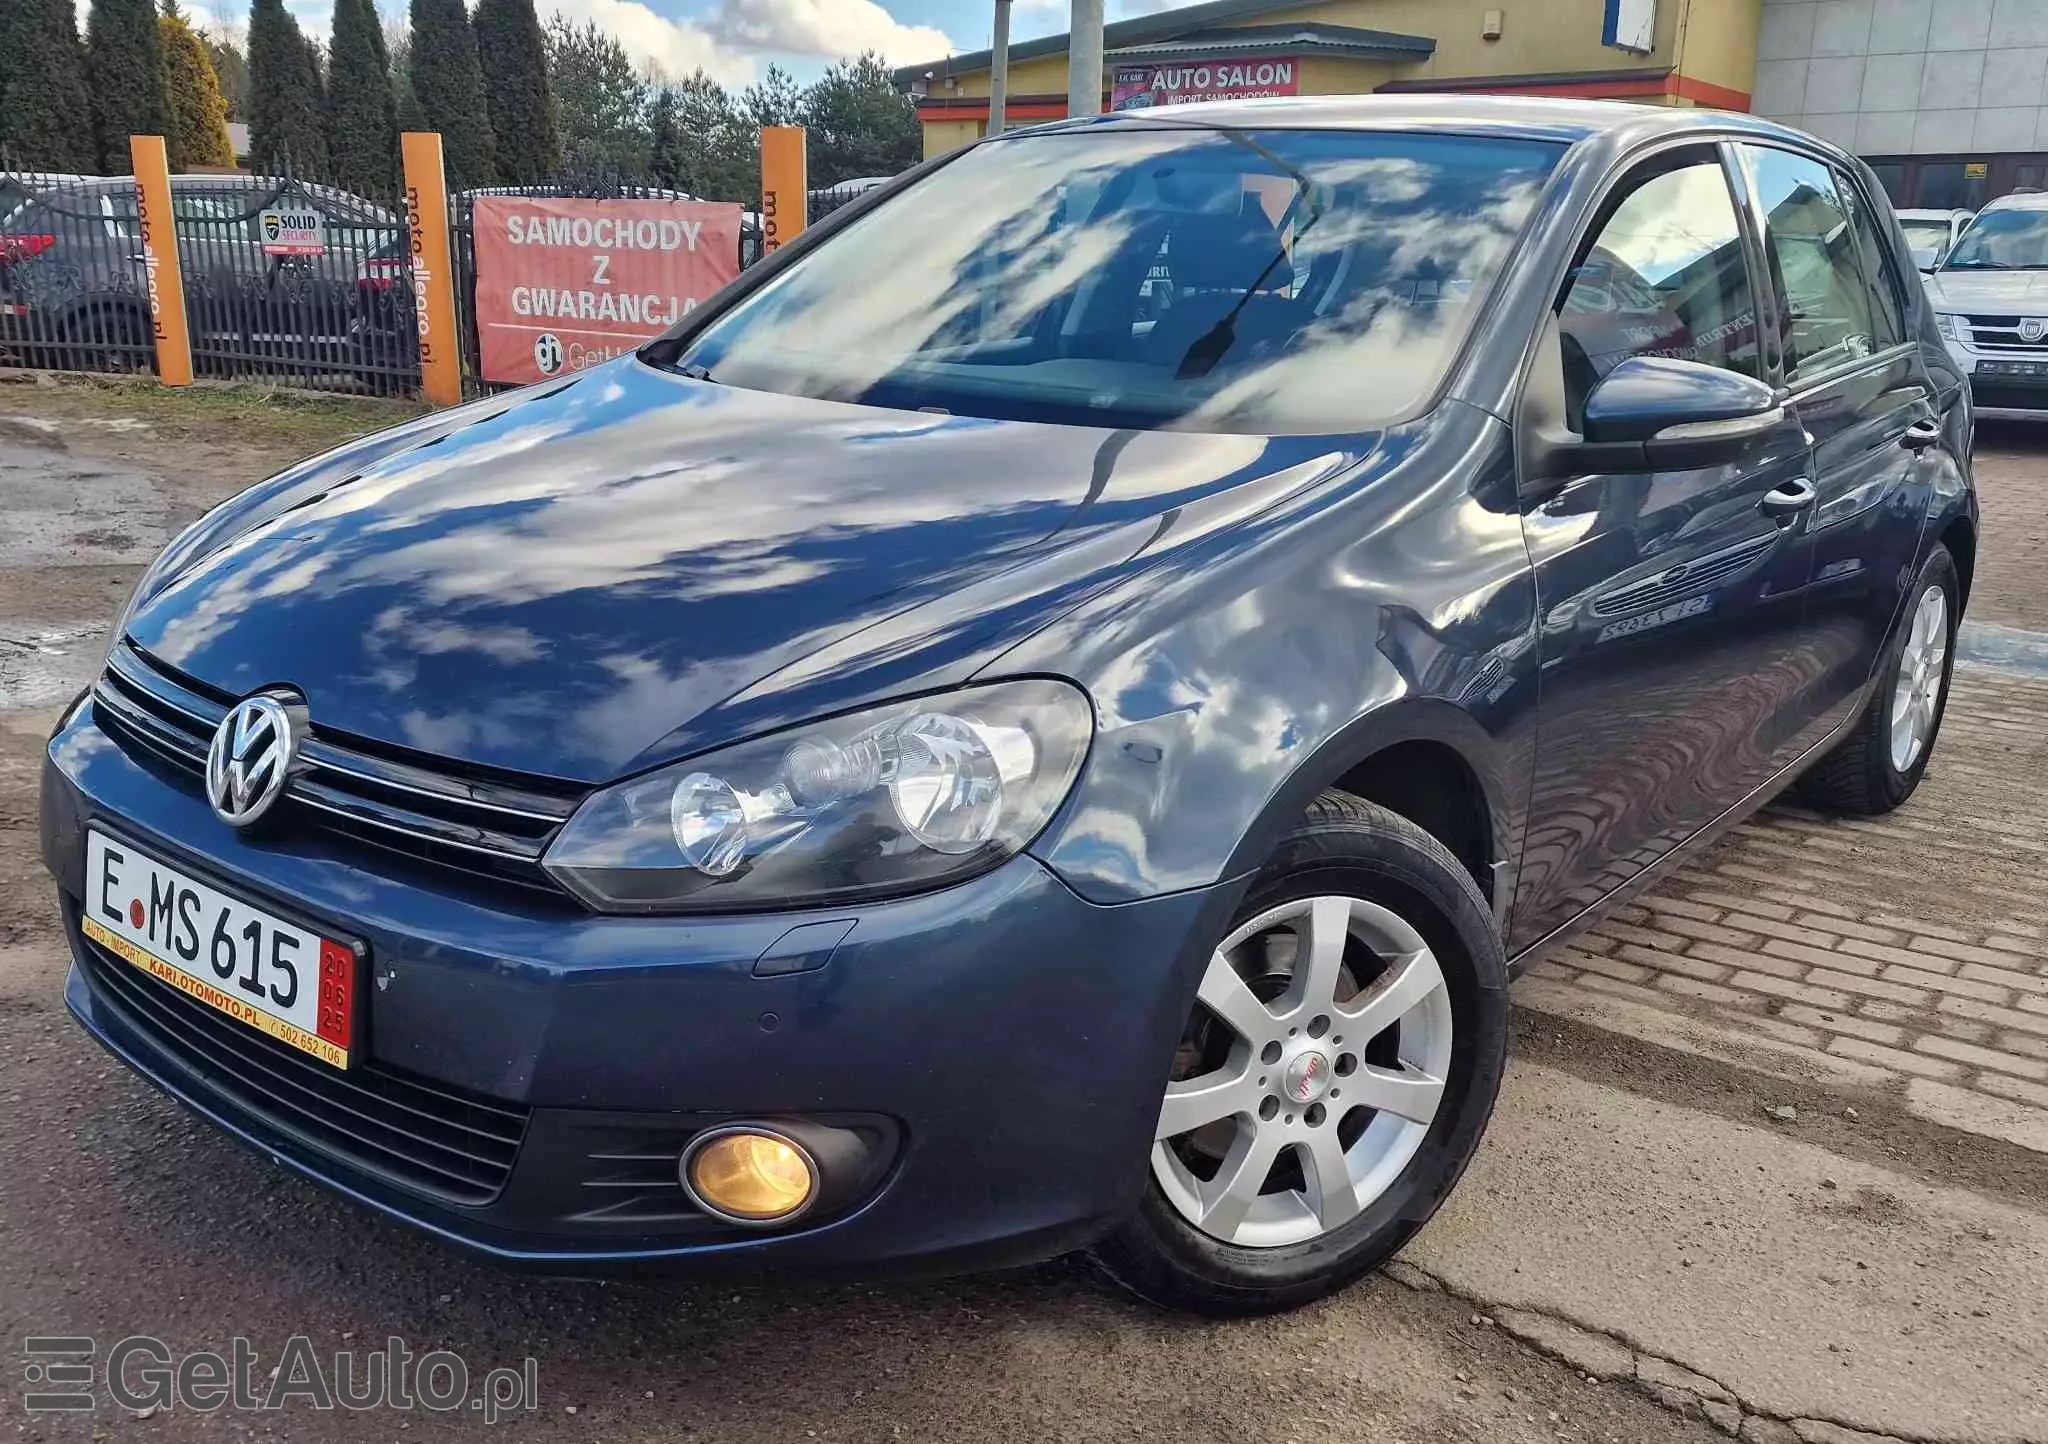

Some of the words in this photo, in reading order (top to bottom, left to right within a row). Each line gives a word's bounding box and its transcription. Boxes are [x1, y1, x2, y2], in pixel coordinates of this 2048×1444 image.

[1152, 66, 1208, 90] AUTO
[1216, 63, 1292, 88] SALON
[1167, 94, 1202, 105] IMPORT
[281, 215, 316, 229] SOLID
[282, 231, 317, 241] SECURITY
[507, 215, 701, 251] SAMOCHODY
[592, 255, 610, 285] Z
[512, 286, 698, 326] GWARANCJA
[102, 847, 124, 923] E
[149, 872, 200, 960] MS
[211, 907, 300, 1008] 615
[86, 921, 105, 942] AUTO
[111, 935, 140, 963] IMPORT
[150, 958, 260, 1027] KARI.OTOMOTO.PL
[280, 1026, 297, 1044] 502
[301, 1036, 318, 1055] 652
[322, 1045, 340, 1064] 106
